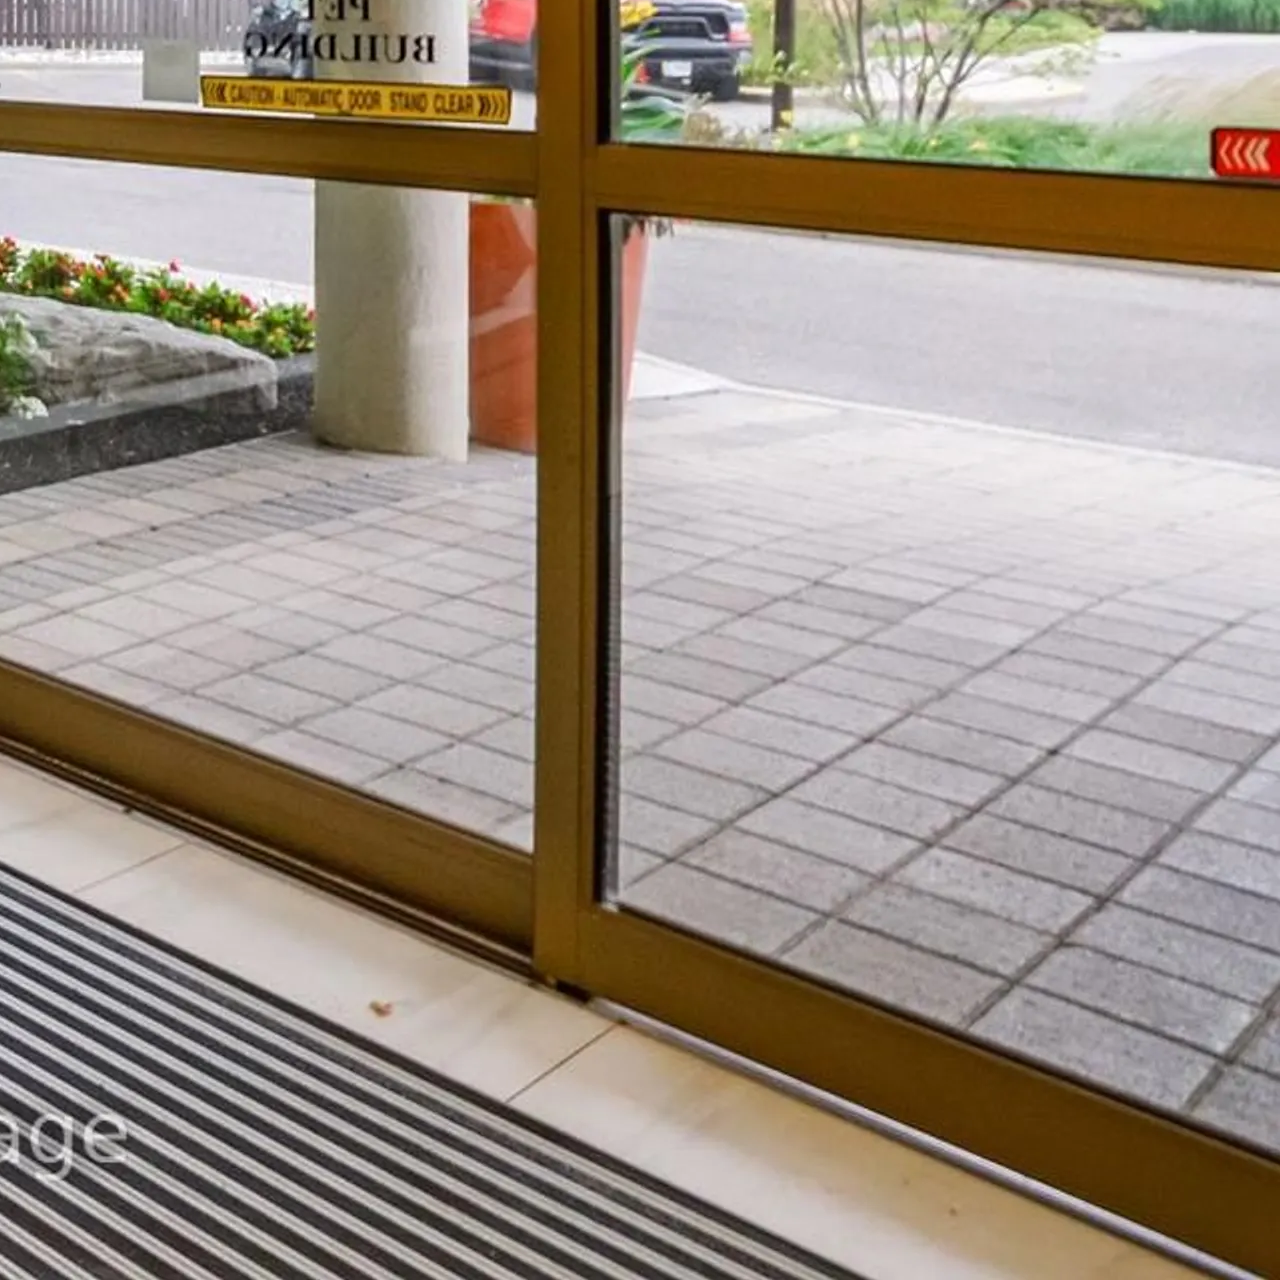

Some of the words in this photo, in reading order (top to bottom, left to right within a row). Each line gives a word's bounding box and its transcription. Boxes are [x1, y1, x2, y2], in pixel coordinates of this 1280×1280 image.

[230, 84, 275, 106] CAUTION
[282, 86, 344, 109] AUTOMATIC
[348, 89, 381, 111] DOOR
[389, 91, 429, 114] STAND
[433, 93, 474, 115] CLEAR
